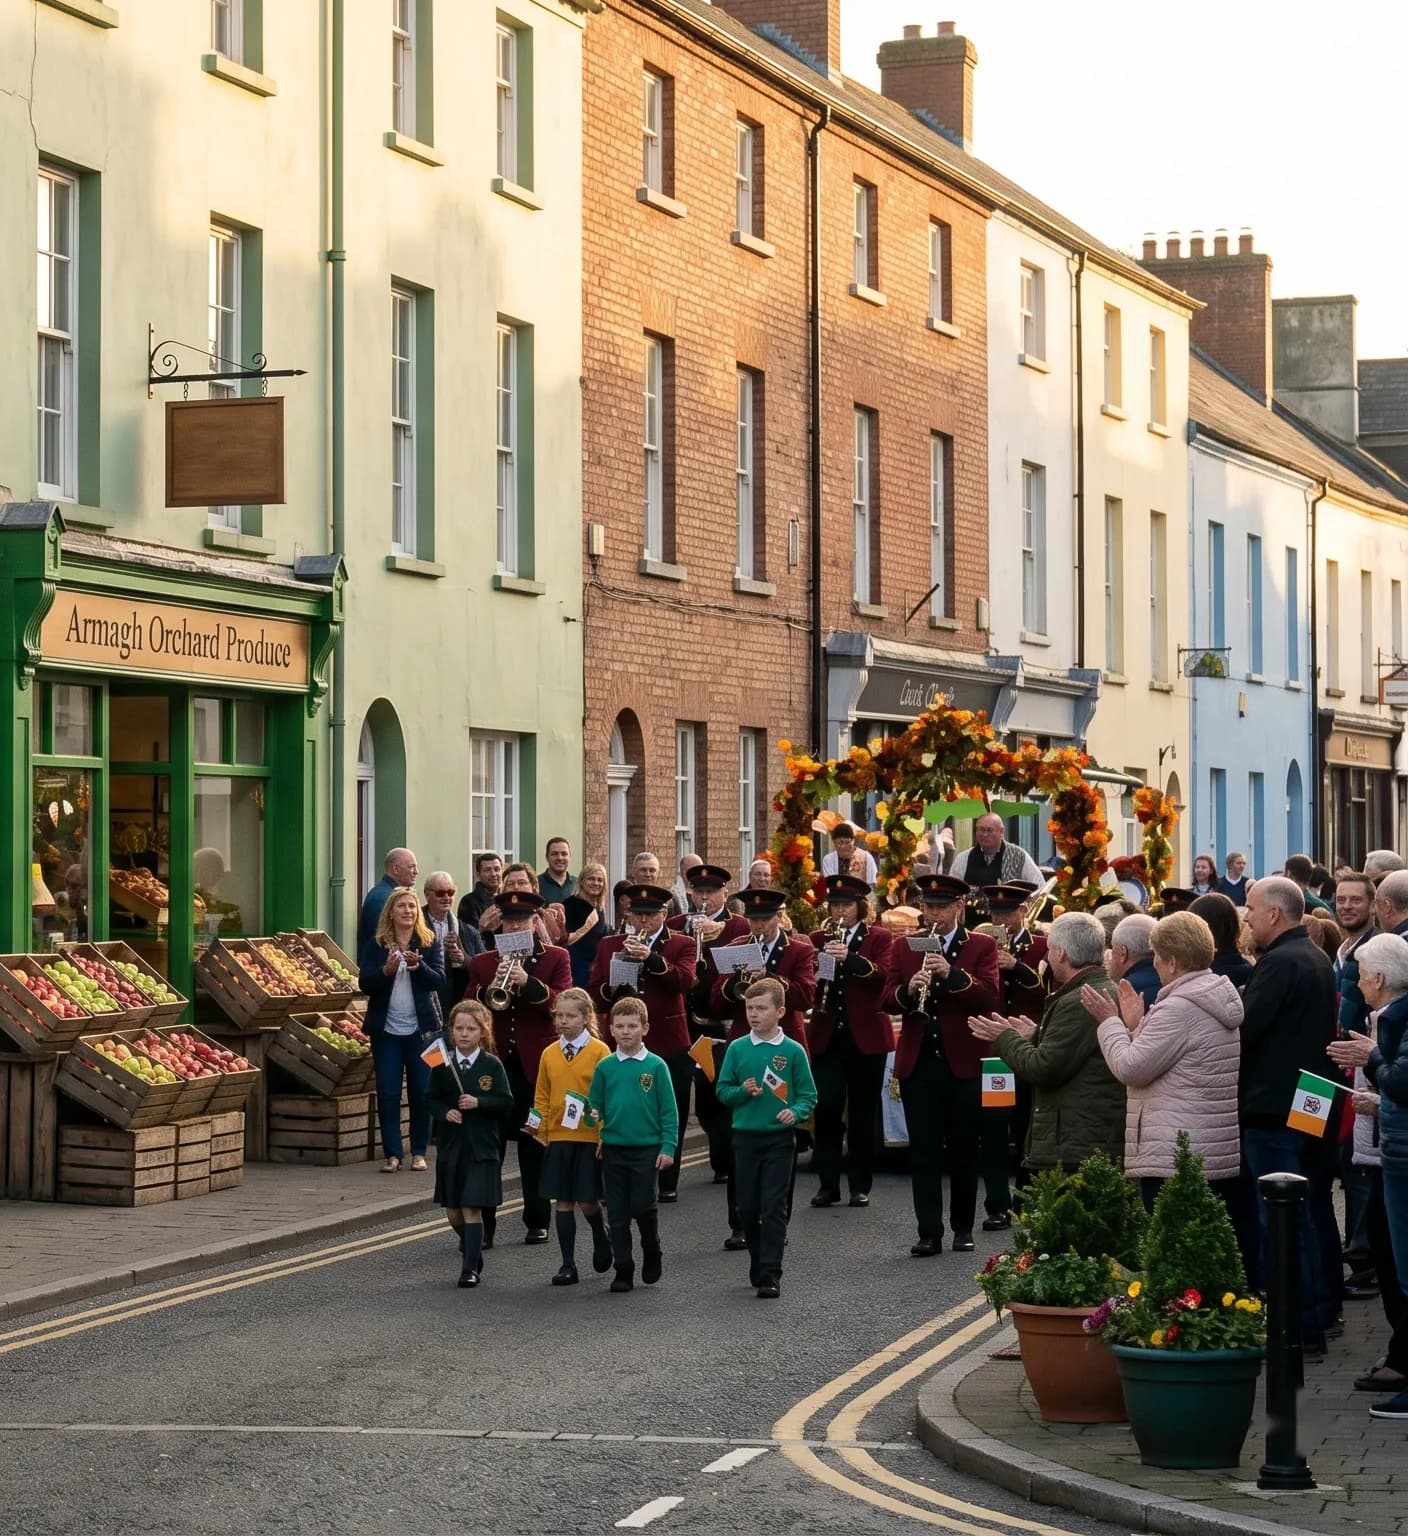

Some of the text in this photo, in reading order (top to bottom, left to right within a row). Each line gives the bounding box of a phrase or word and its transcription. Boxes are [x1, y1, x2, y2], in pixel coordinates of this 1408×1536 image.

[65, 604, 291, 669] Armagh Orchard Produce
